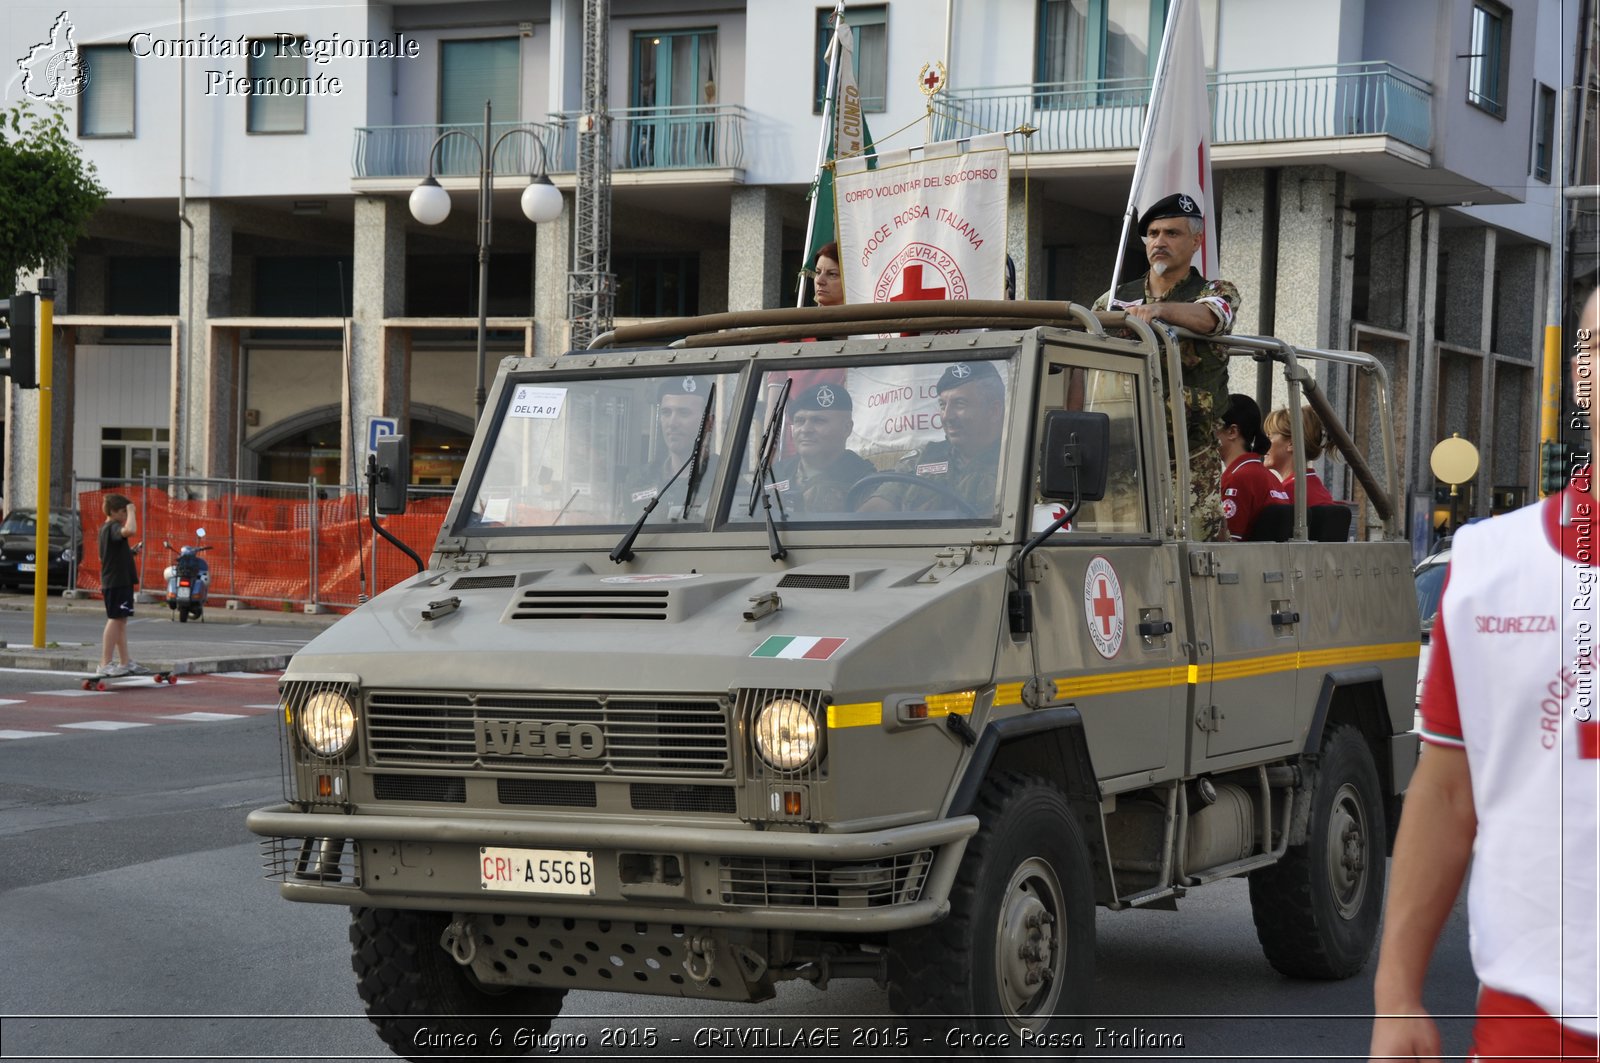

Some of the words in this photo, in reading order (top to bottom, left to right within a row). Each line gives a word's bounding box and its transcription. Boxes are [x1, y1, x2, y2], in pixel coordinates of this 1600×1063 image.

[843, 85, 860, 138] CUNEO
[845, 188, 874, 203] CORPO
[924, 175, 942, 188] DEL
[861, 224, 893, 268] CROCE
[893, 205, 930, 230] ROSSA
[935, 207, 985, 251] ITALIANA
[875, 273, 894, 303] IONE
[937, 255, 951, 271] 22
[514, 405, 544, 414] DELTA
[546, 406, 557, 415] 01
[868, 386, 913, 408] COMITATO
[1089, 621, 1107, 654] CORPO
[1475, 616, 1556, 634] SICUREZZA
[1541, 666, 1577, 750] CROCE
[473, 720, 606, 759] IVECO
[483, 856, 513, 882] CRI
